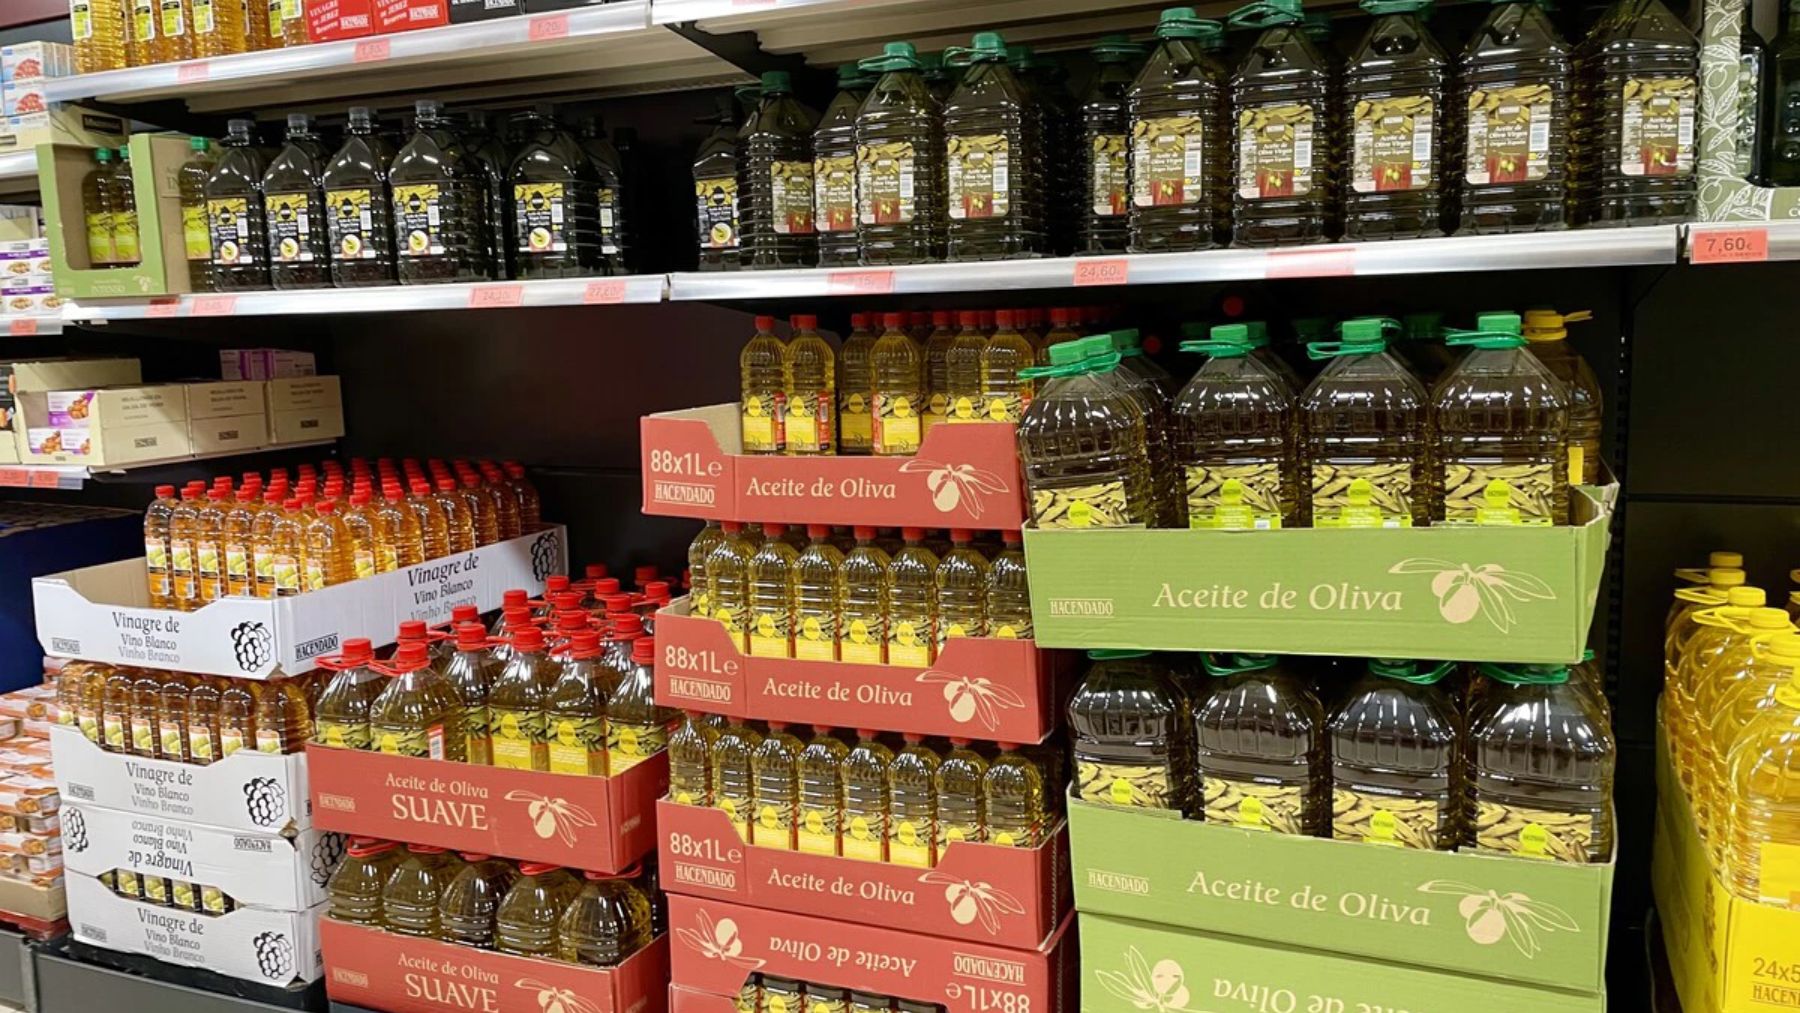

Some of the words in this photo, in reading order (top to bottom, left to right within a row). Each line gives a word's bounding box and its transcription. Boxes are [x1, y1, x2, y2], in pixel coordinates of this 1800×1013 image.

[655, 483, 715, 504] HACENDADO
[746, 477, 808, 498] Aceite
[811, 477, 834, 498] de
[839, 477, 897, 500] Oliva
[408, 560, 461, 587] Vinagre
[464, 552, 479, 571] de
[414, 589, 437, 605] Vino
[440, 579, 473, 598] Blanco
[1153, 584, 1248, 610] Aceite
[1260, 584, 1298, 611] de
[1308, 584, 1404, 613] Oliva
[1049, 601, 1114, 617] HACENDADO
[112, 611, 161, 635] Vinagre
[165, 616, 180, 633] de
[121, 633, 143, 647] Vino
[145, 636, 177, 650] Blanco
[118, 646, 145, 660] Vinho
[147, 648, 180, 663] Branco
[670, 677, 731, 701] HACENDADO
[763, 677, 823, 699] Aceite
[827, 681, 851, 702] de
[856, 683, 912, 706] Oliva
[126, 761, 174, 786] Vinagre
[178, 769, 193, 786] de
[385, 772, 426, 791] Aceite
[429, 777, 446, 793] de
[450, 780, 489, 799] Oliva
[134, 783, 156, 797] Vino
[158, 785, 190, 801] Blanco
[131, 795, 159, 809] Vinho
[161, 800, 194, 815] Branco
[391, 793, 489, 831] SUAVE
[131, 820, 164, 837] Branco
[166, 825, 193, 842] Vinho
[133, 833, 163, 850] Blanco
[165, 839, 187, 854] Vino
[128, 850, 142, 868] de
[145, 851, 193, 876] Vinagre
[675, 864, 736, 889] HACENDADO
[767, 868, 826, 892] Aceite
[830, 874, 854, 896] de
[859, 880, 916, 906] Oliva
[1088, 871, 1149, 894] HACENDADO
[1186, 872, 1279, 906] Aceite
[1289, 882, 1328, 912] de
[1338, 892, 1431, 927] Oliva
[137, 907, 186, 933] Vinagre
[189, 918, 204, 935] de
[145, 928, 167, 943] Vino
[169, 933, 201, 950] Blanco
[769, 936, 822, 962] Oliva
[144, 941, 171, 956] Vinho
[173, 946, 205, 963] Branco
[826, 947, 851, 966] de
[398, 952, 438, 973] Aceite
[441, 961, 458, 976] de
[461, 965, 499, 984] Oliva
[855, 953, 917, 977] Aceite
[954, 955, 1024, 982] HACENDADO
[405, 973, 499, 1013] SUAVE
[1213, 979, 1297, 1013] Oliva
